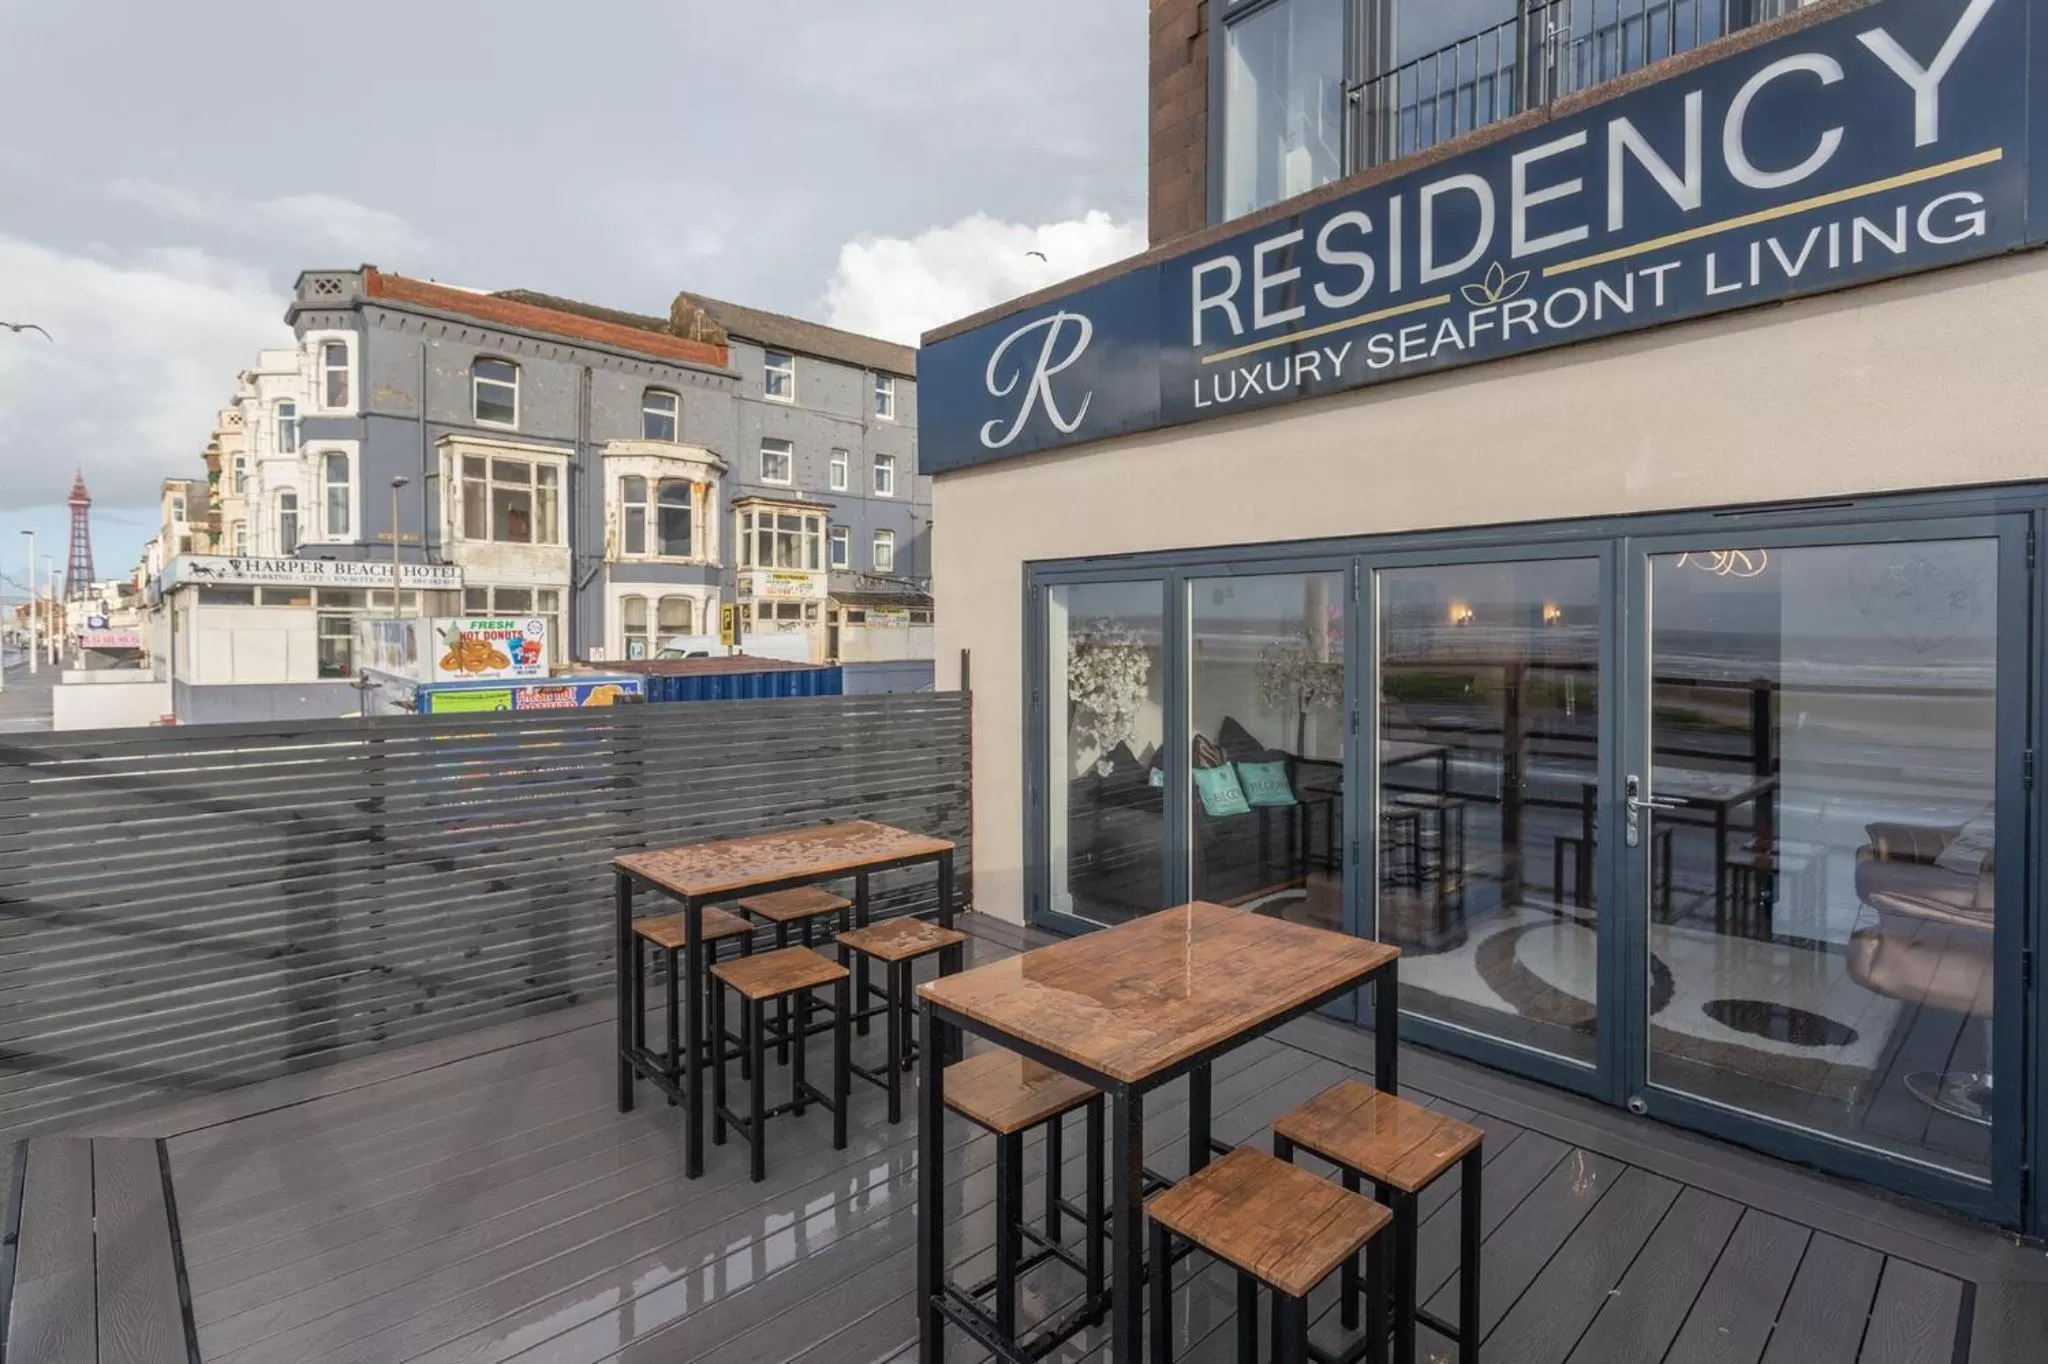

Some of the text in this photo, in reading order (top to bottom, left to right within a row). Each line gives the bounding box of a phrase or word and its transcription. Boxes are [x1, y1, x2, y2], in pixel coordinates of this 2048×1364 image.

[1192, 0, 1996, 347] RESIDENCY
[1194, 191, 1986, 408] LUXURY SEAFRONT LIVING
[980, 310, 1093, 449] R
[245, 560, 456, 578] HARPER BEACH HOTEL
[460, 630, 524, 641] HOT DONUTS
[470, 620, 515, 630] FRESH
